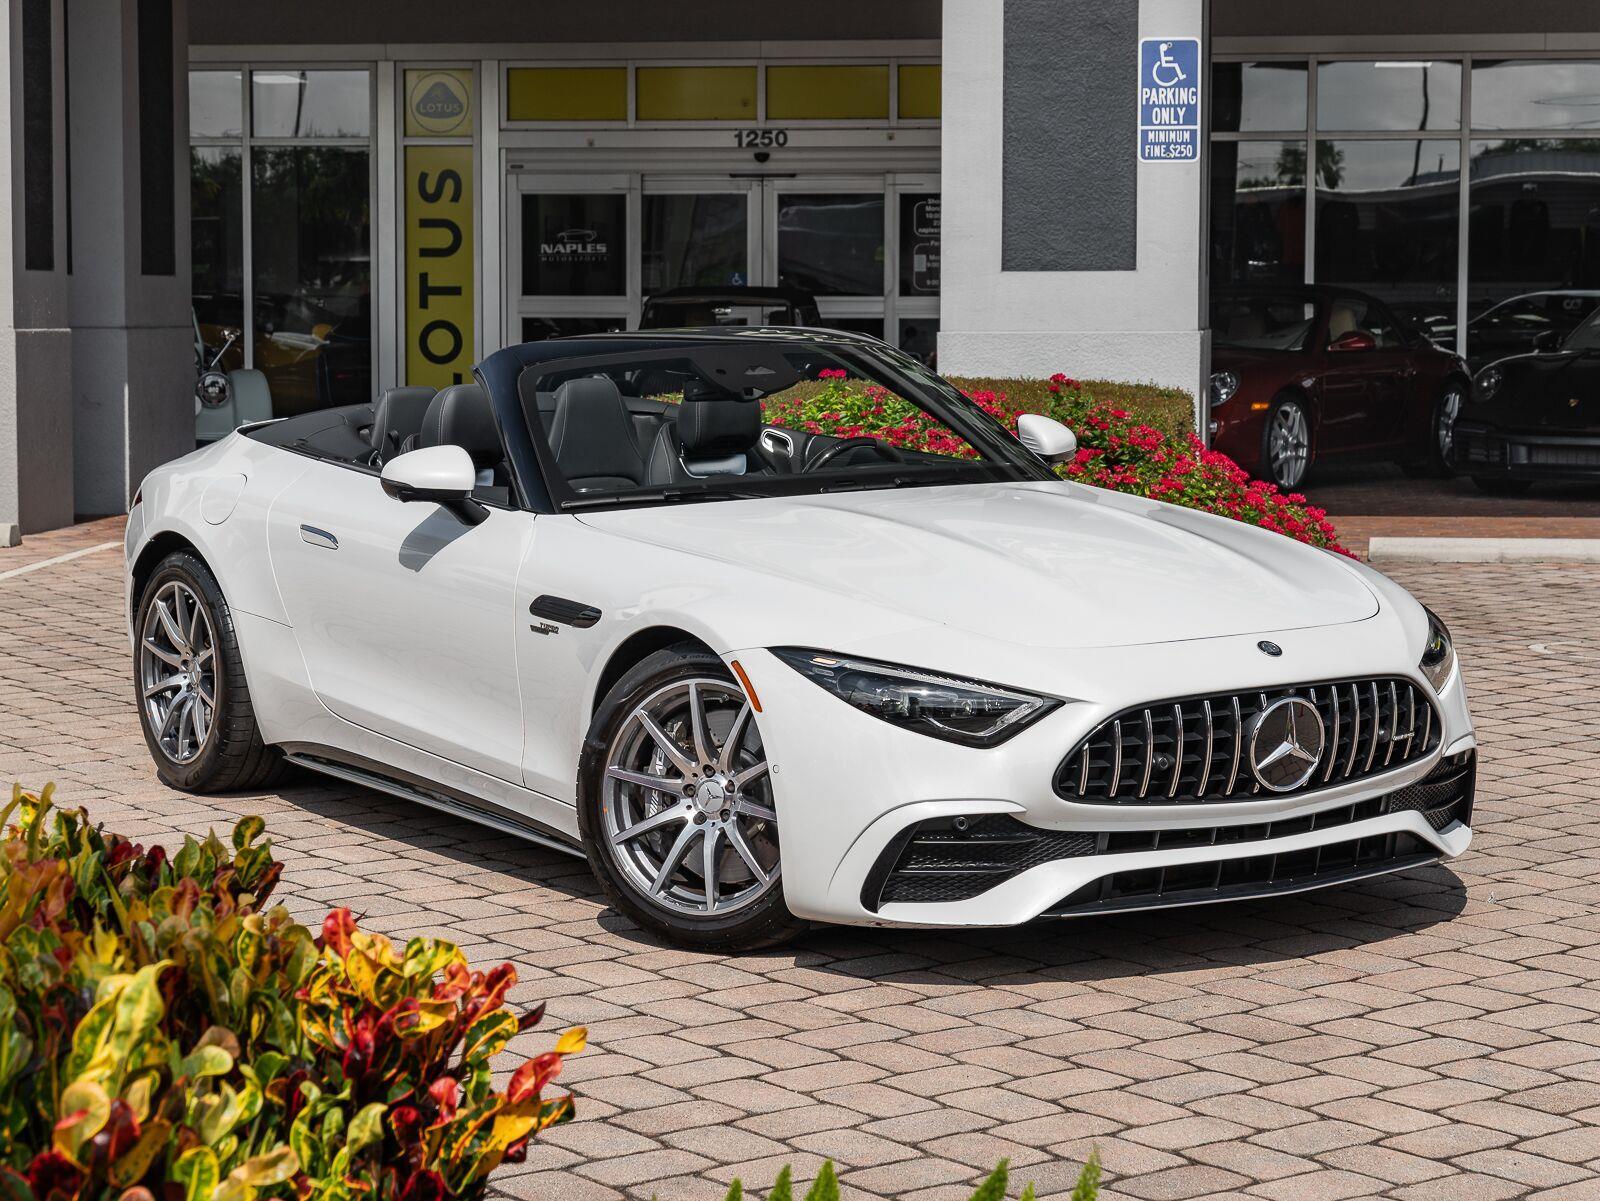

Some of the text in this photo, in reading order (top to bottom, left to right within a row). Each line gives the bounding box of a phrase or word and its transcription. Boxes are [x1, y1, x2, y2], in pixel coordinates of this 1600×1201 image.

[1142, 87, 1197, 105] PARKING
[419, 102, 460, 113] LOTUS
[1152, 107, 1186, 124] ONLY
[734, 129, 788, 148] 1250
[1148, 131, 1190, 142] MINIMUM
[1145, 144, 1193, 158] FINE $250
[541, 243, 607, 253] NAPLES
[418, 168, 463, 386] OTUS
